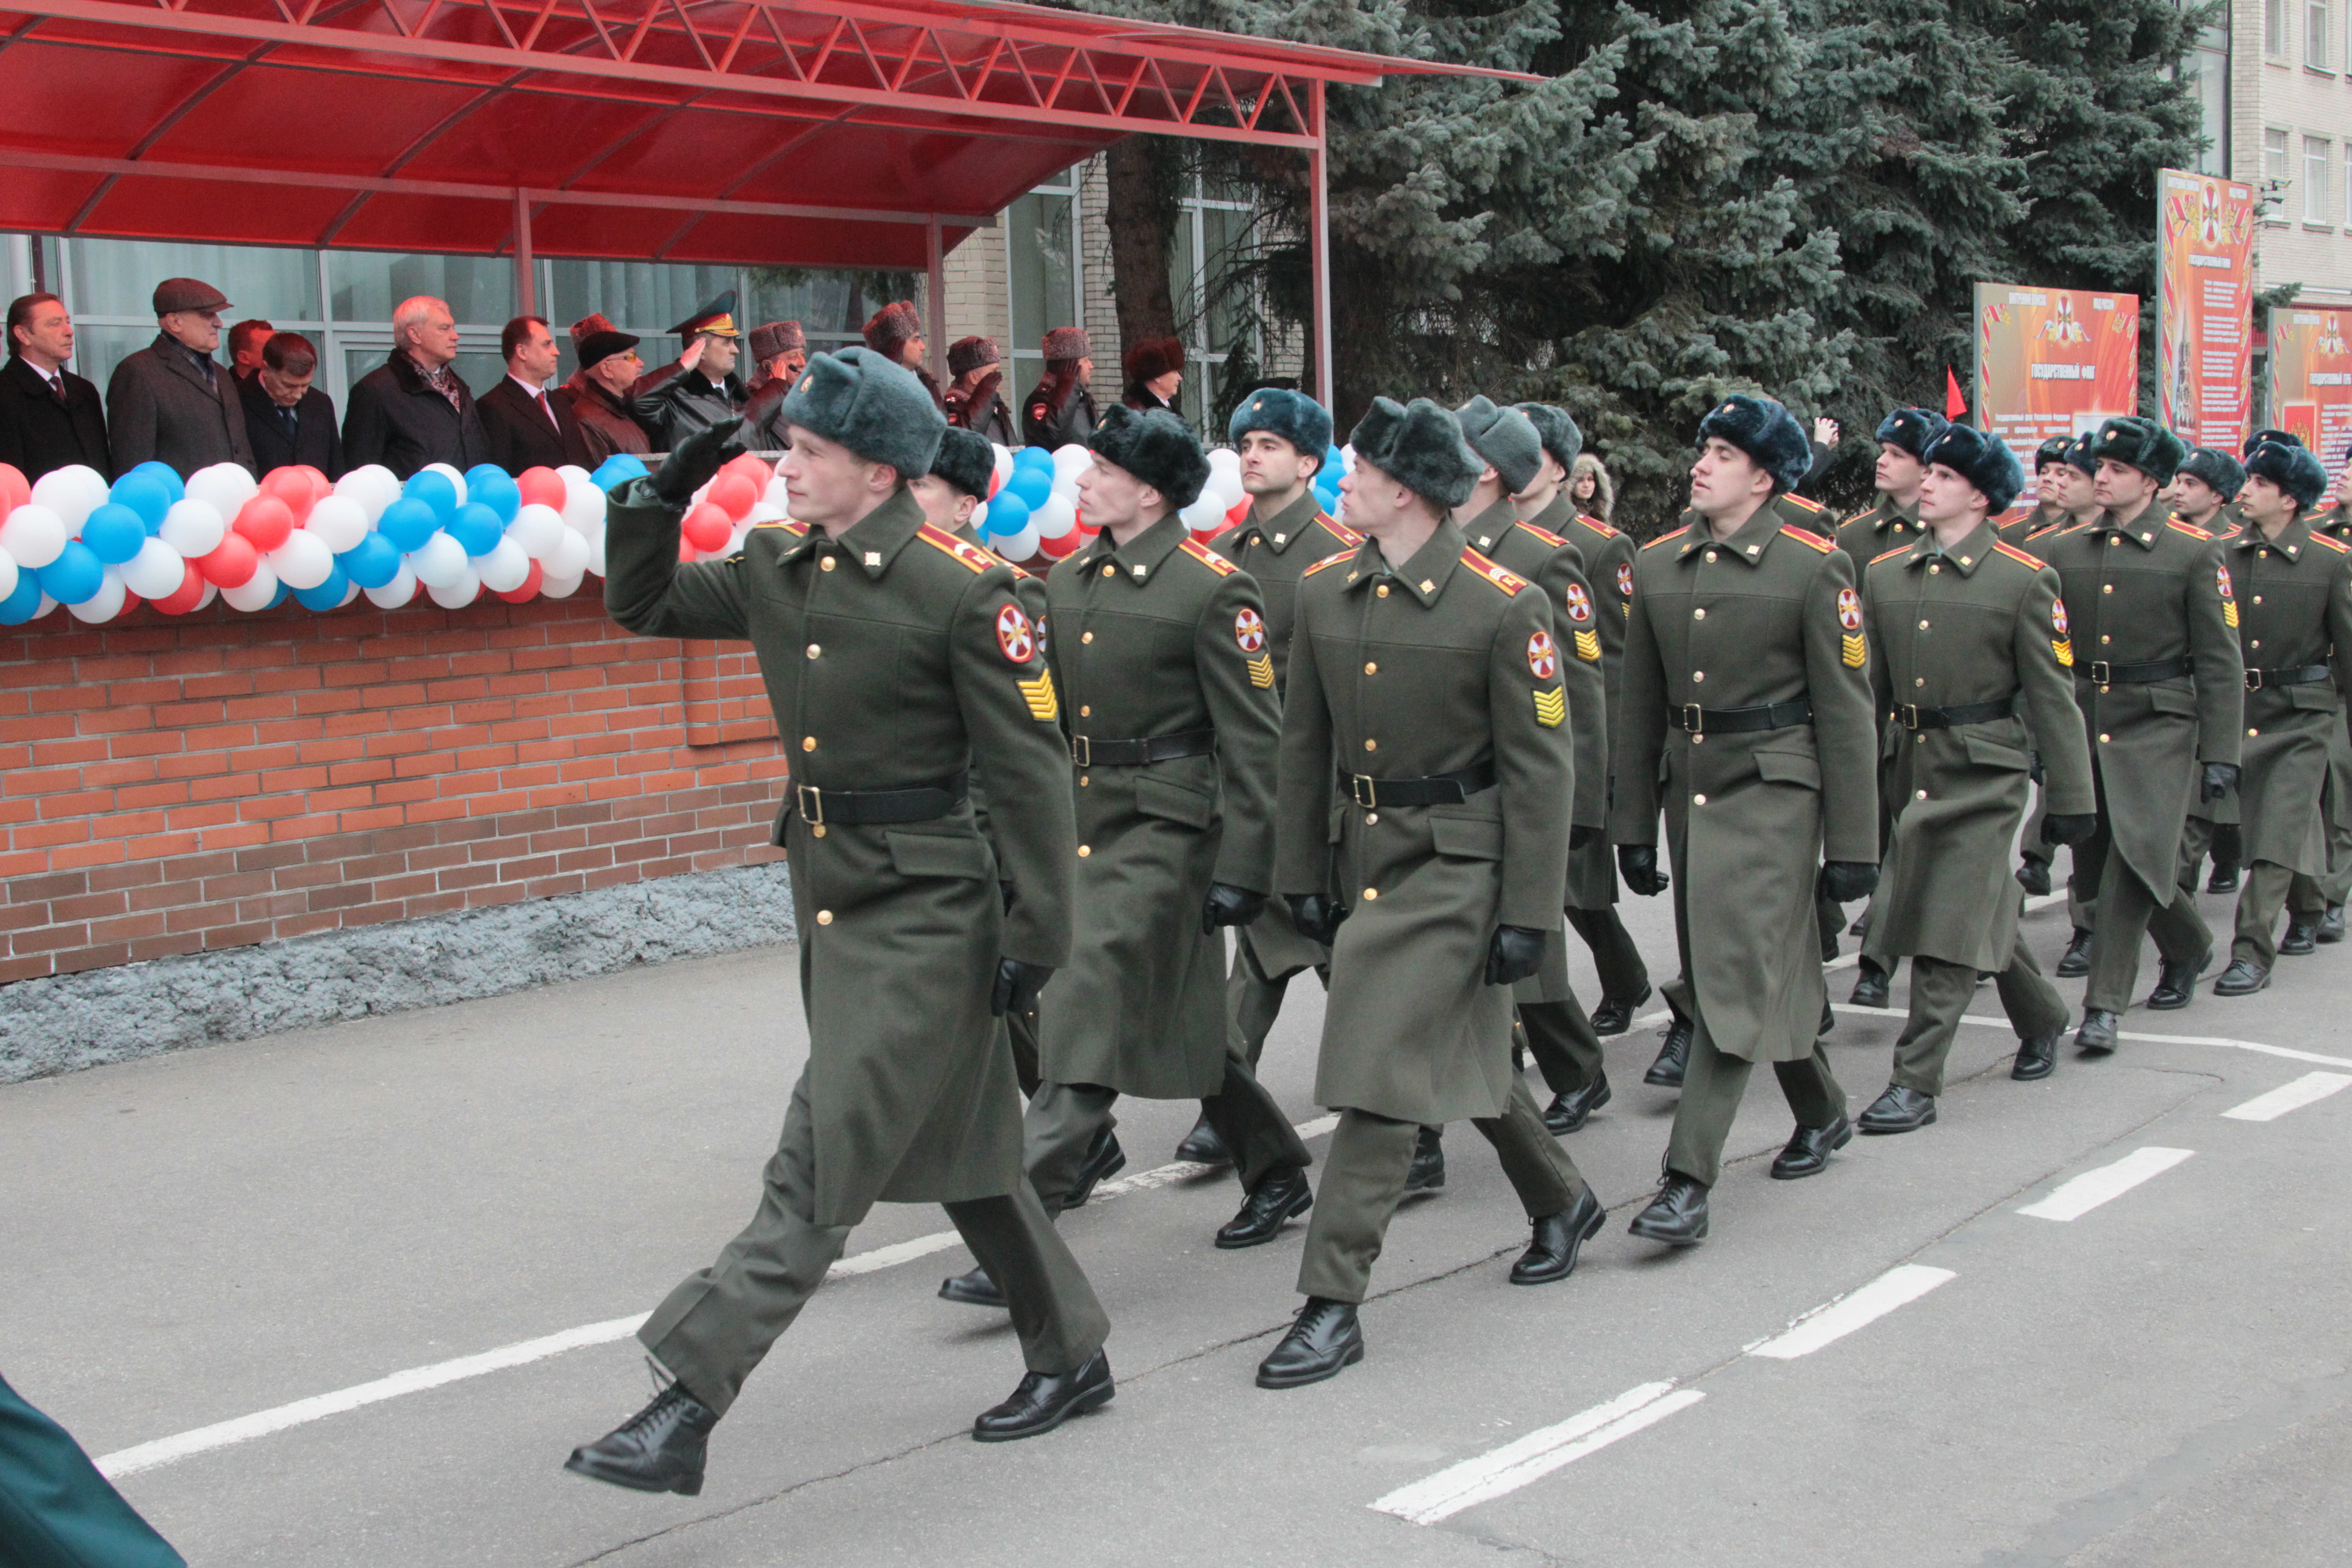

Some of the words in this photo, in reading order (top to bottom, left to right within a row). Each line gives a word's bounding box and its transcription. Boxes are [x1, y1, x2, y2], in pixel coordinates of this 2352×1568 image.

[2189, 254, 2221, 268] ГОСУДАРСТВЕННЫЙ
[2031, 362, 2080, 380] ГОСУДАРСТВЕННЫЙ
[2082, 365, 2095, 380] ФЛАГ
[2310, 371, 2342, 386] ГОСУДАРСТВЕННЫЙ
